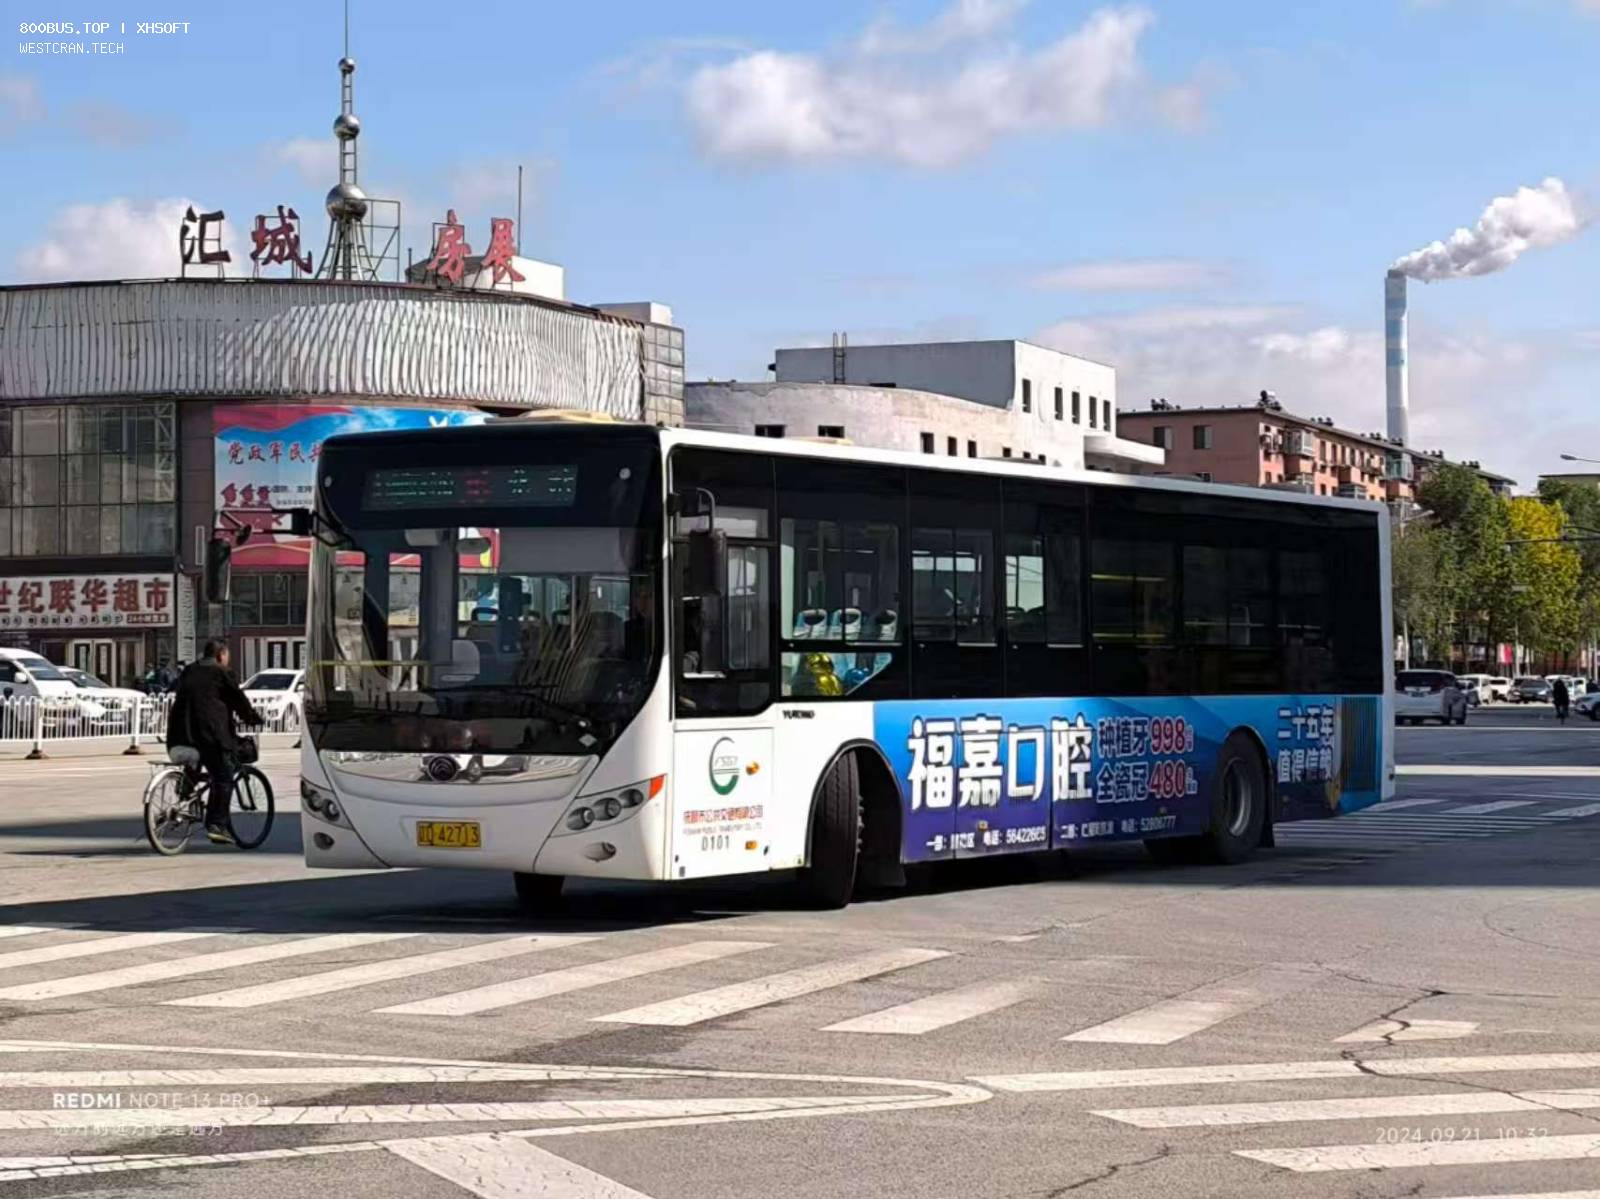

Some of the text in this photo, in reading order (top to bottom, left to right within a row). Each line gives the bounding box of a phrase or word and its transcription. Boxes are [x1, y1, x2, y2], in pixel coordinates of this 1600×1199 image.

[907, 711, 1094, 811] 福嘉口腔
[1278, 704, 1335, 748] 二十五年
